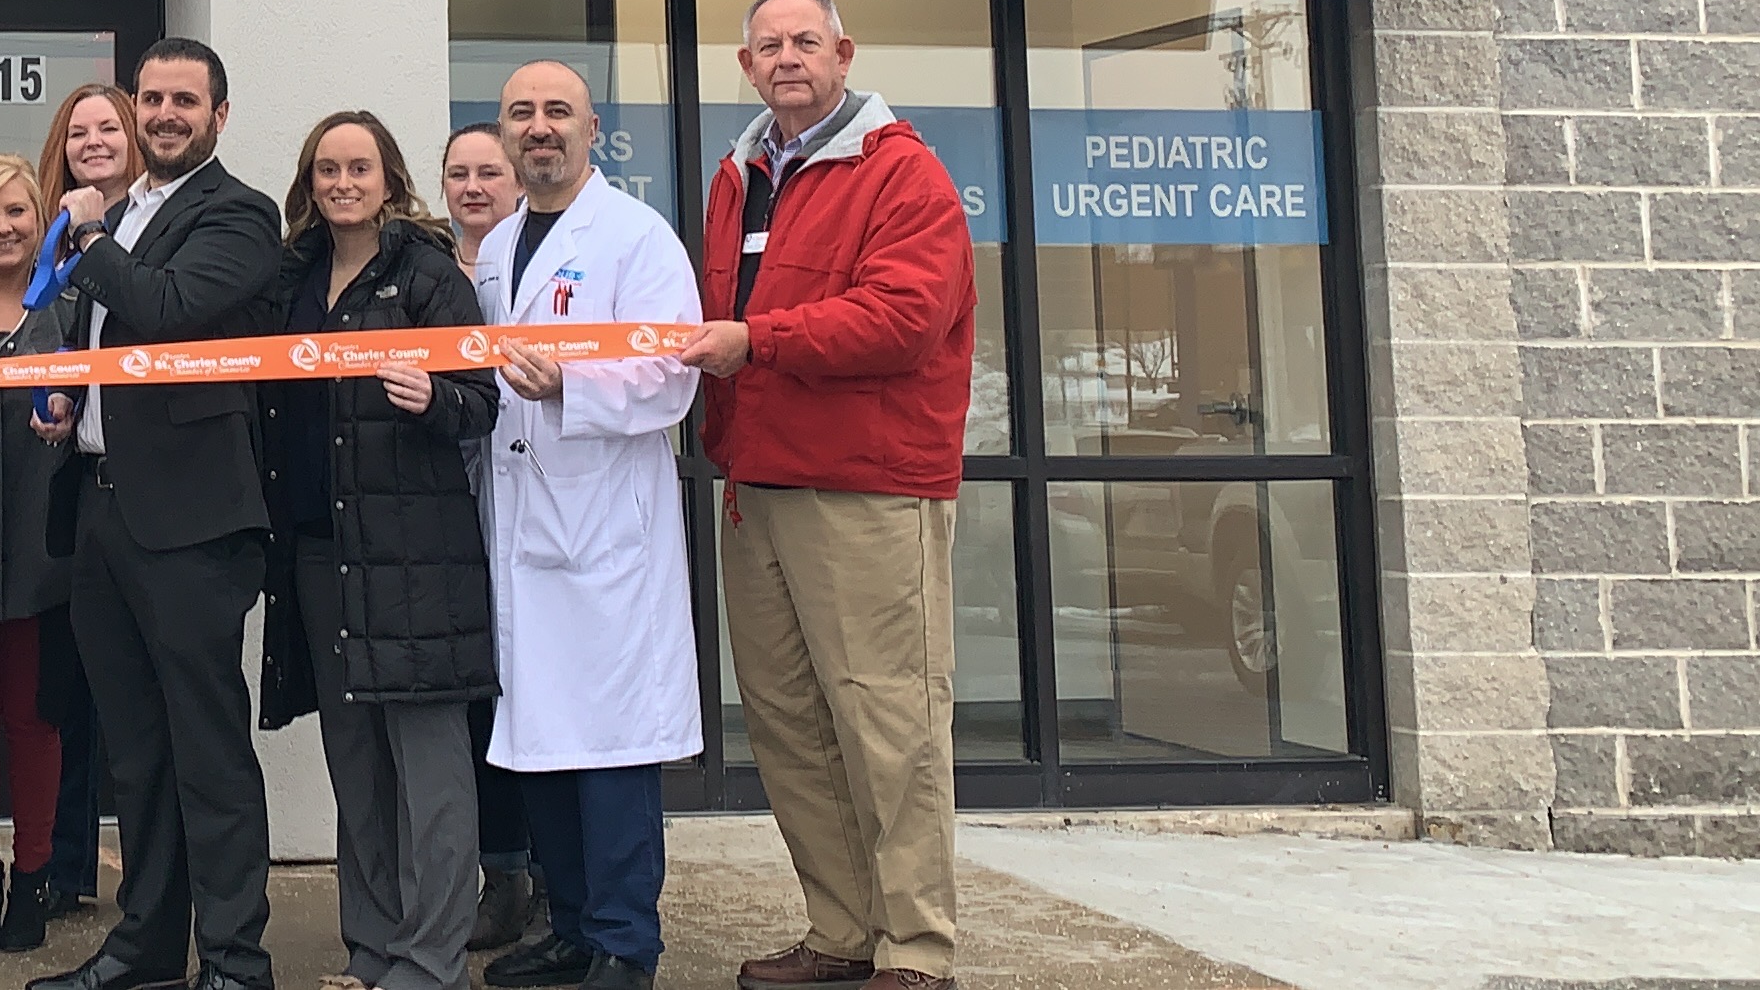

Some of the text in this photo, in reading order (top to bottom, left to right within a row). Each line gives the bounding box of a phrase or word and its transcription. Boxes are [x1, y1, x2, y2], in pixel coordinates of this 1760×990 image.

[1086, 134, 1269, 170] PEDIATRIC
[1052, 183, 1307, 218] URGENT CARE
[558, 340, 600, 353] County
[173, 357, 218, 369] Charles
[219, 354, 262, 368] County
[323, 347, 430, 363] St. Charles County
[2, 365, 47, 376] Charles
[48, 363, 91, 374] County
